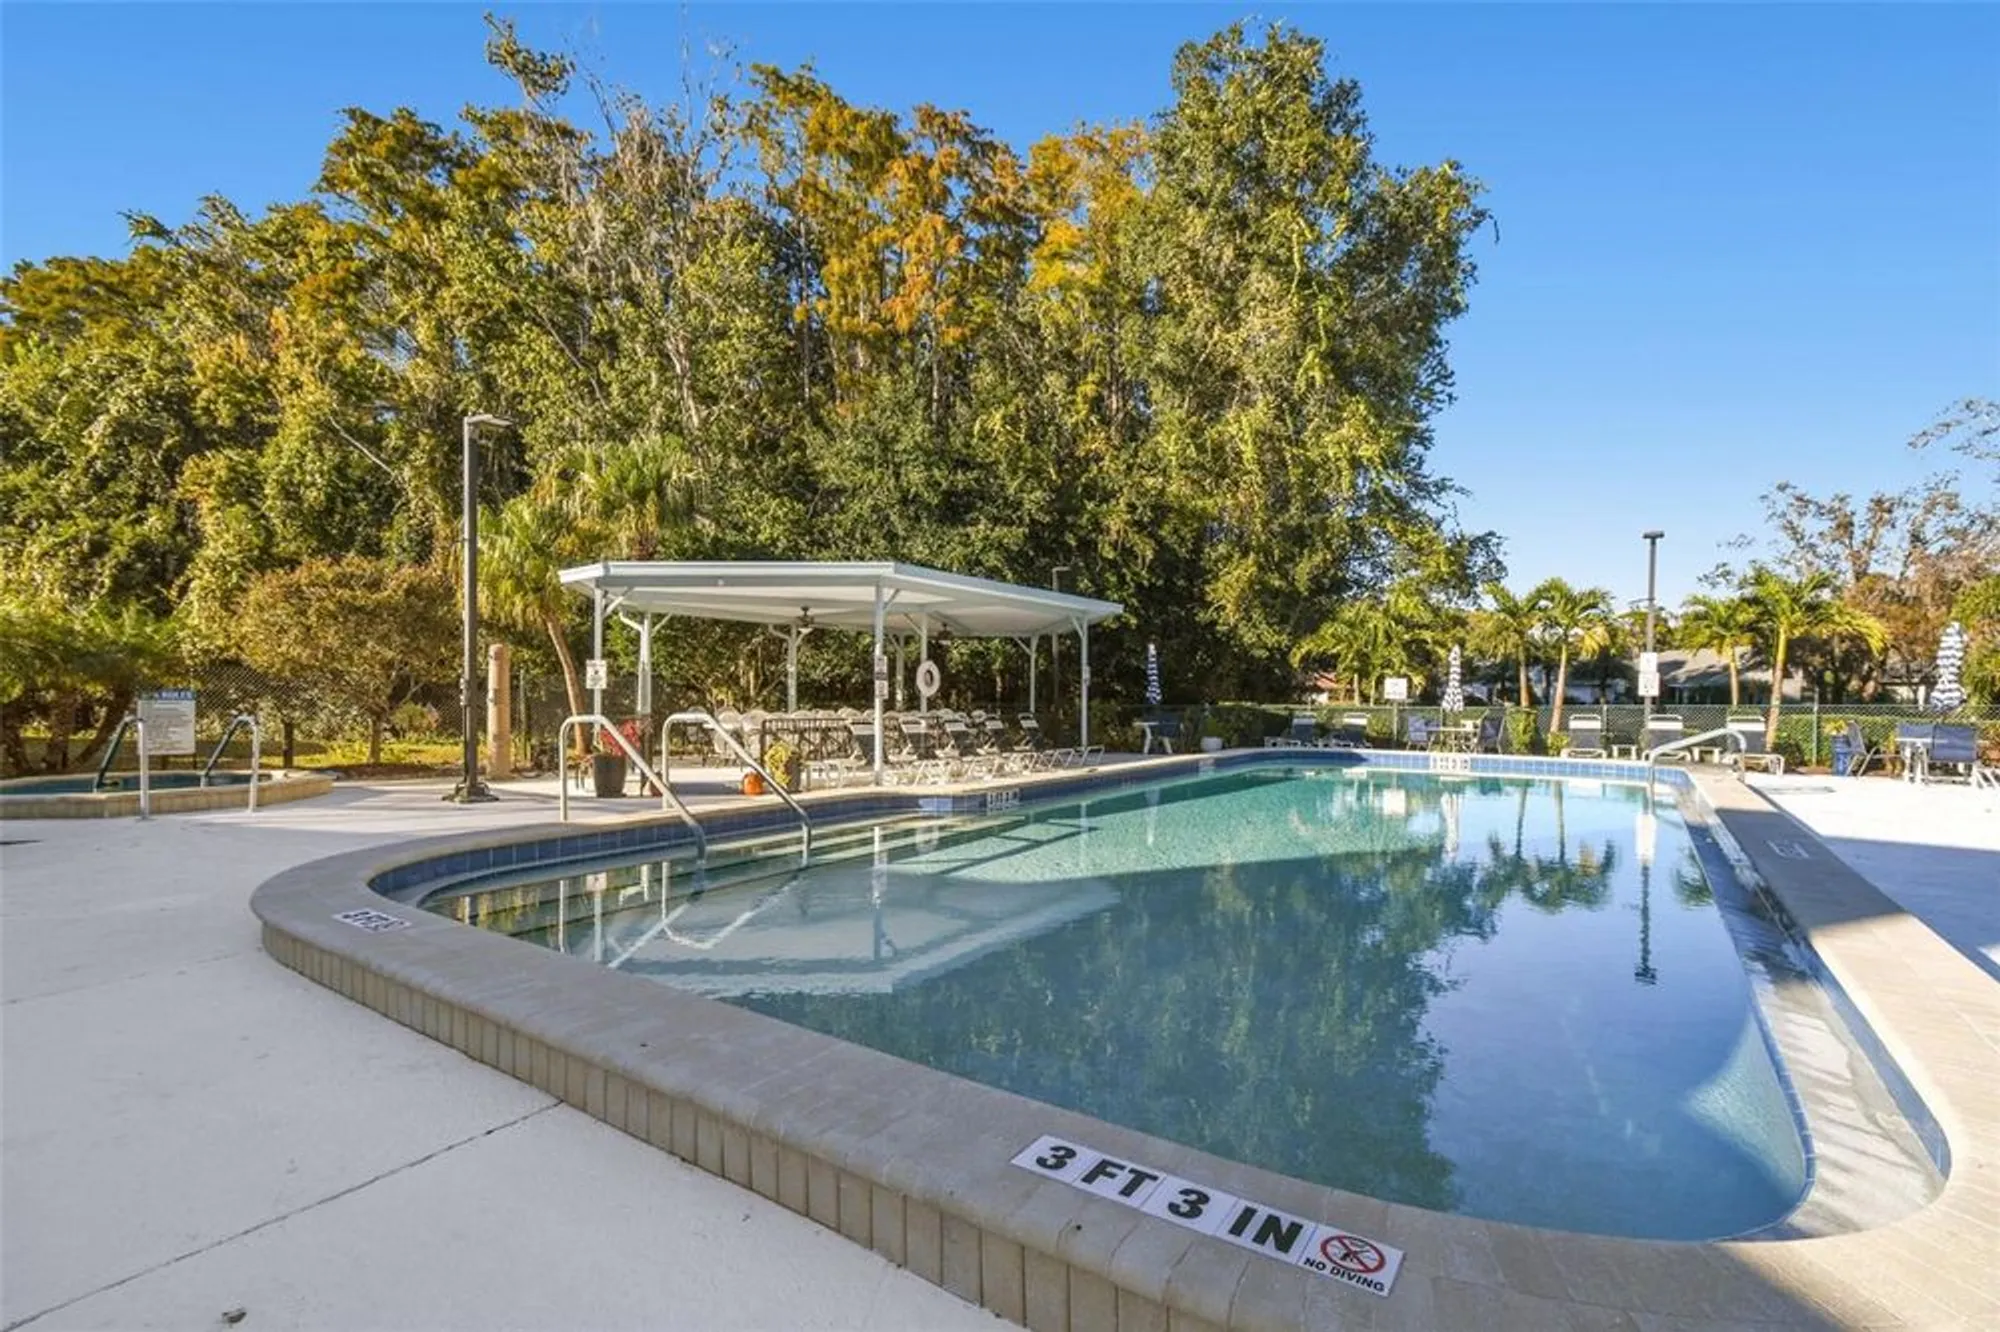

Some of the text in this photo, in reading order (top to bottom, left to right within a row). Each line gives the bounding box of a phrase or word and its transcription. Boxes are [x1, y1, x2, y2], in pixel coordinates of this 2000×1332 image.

[1035, 1145, 1304, 1254] 3 FT 3 IN
[1303, 1257, 1385, 1292] NO DIVING
